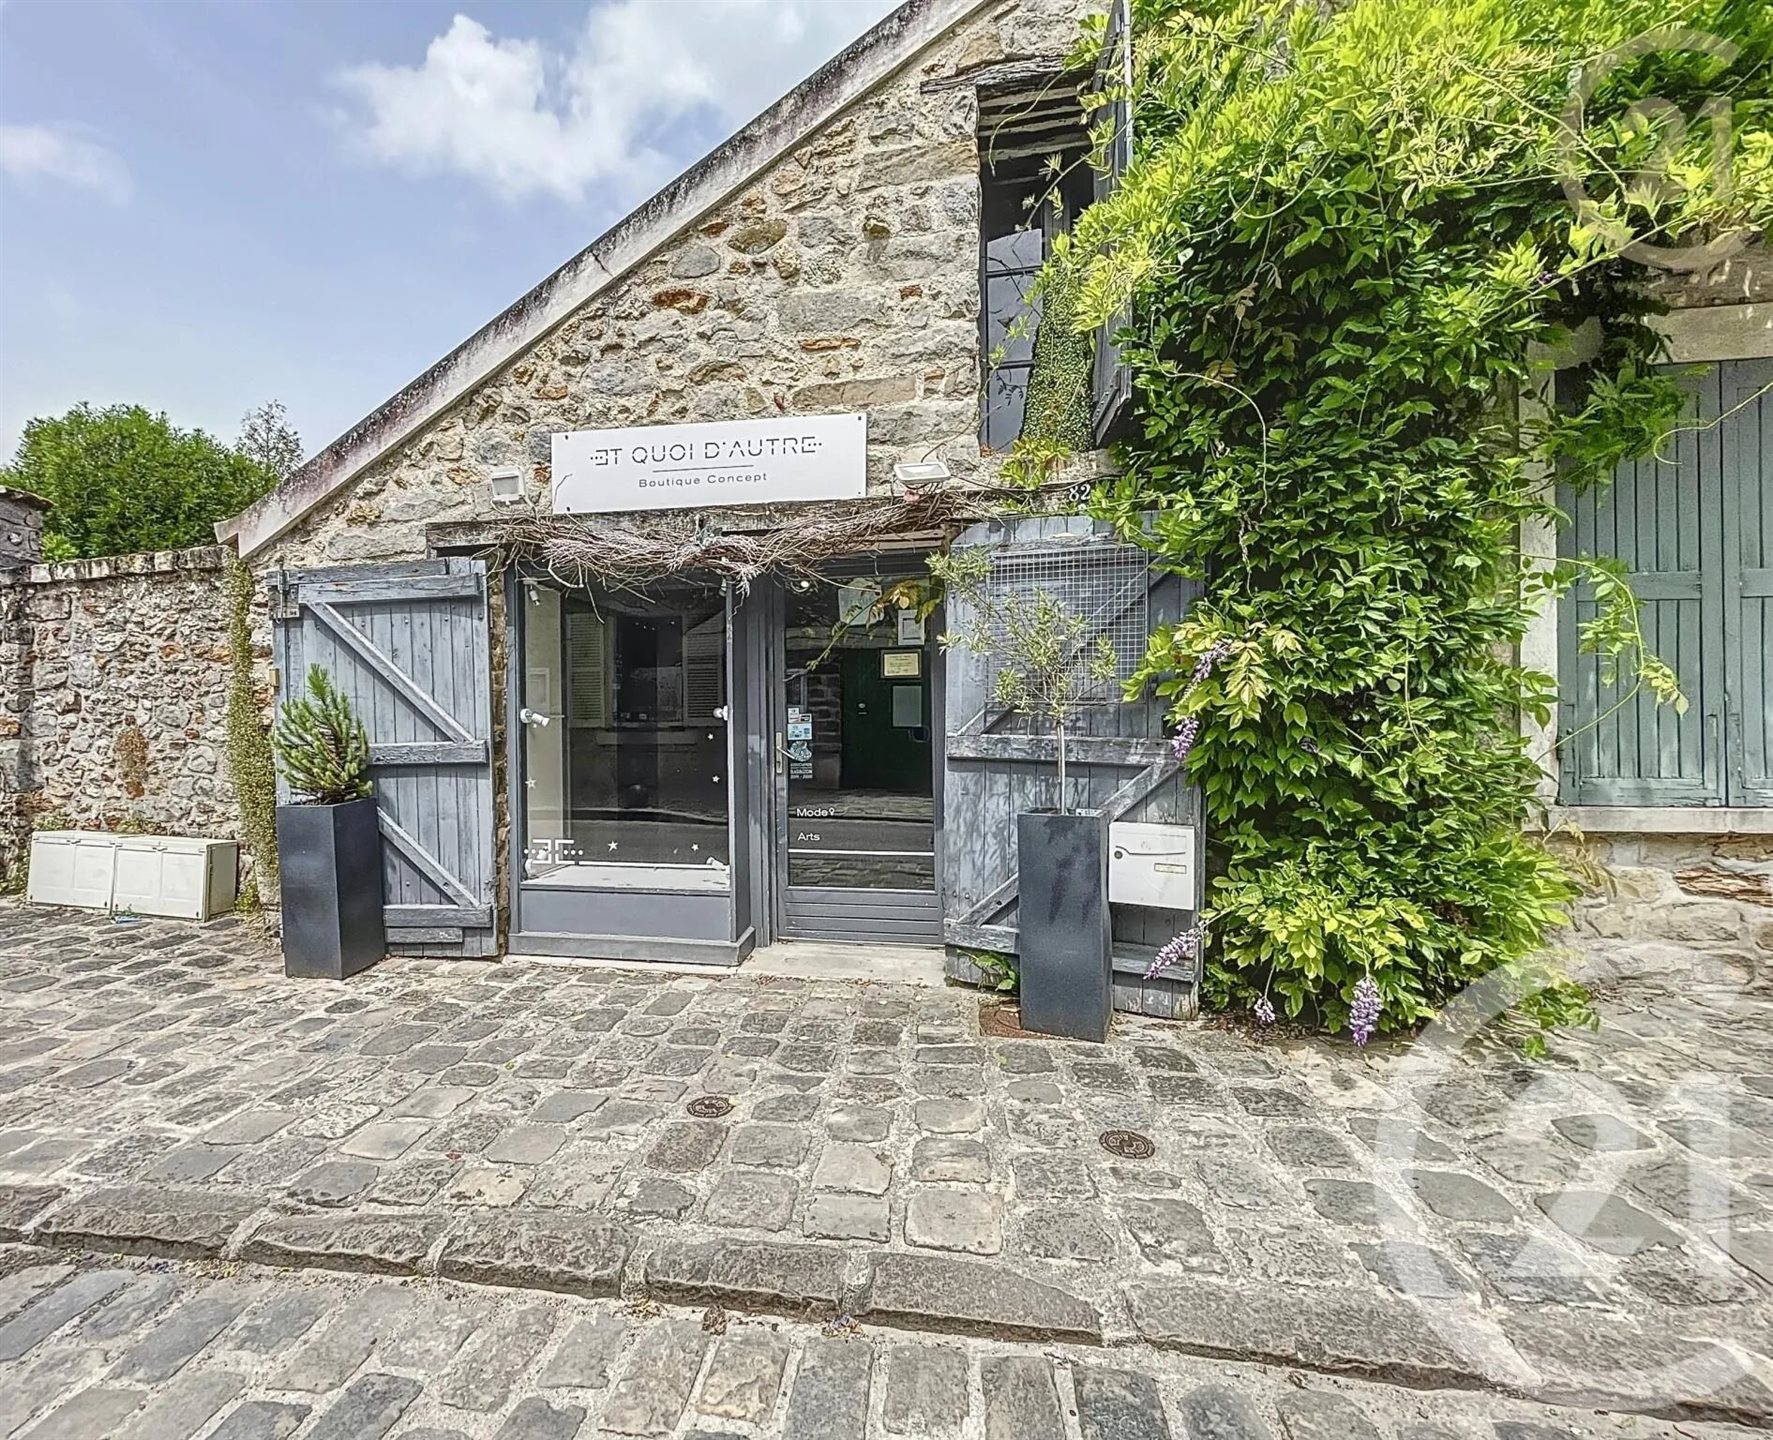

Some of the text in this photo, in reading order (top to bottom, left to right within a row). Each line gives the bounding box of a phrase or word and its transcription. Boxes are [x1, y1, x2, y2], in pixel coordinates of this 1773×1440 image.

[631, 443, 693, 465] QUOI
[704, 436, 819, 459] D'AUTRE
[639, 472, 768, 489] Boutique Concept
[1068, 483, 1091, 502] 82
[796, 807, 829, 817] Mode
[797, 832, 821, 841] Arts
